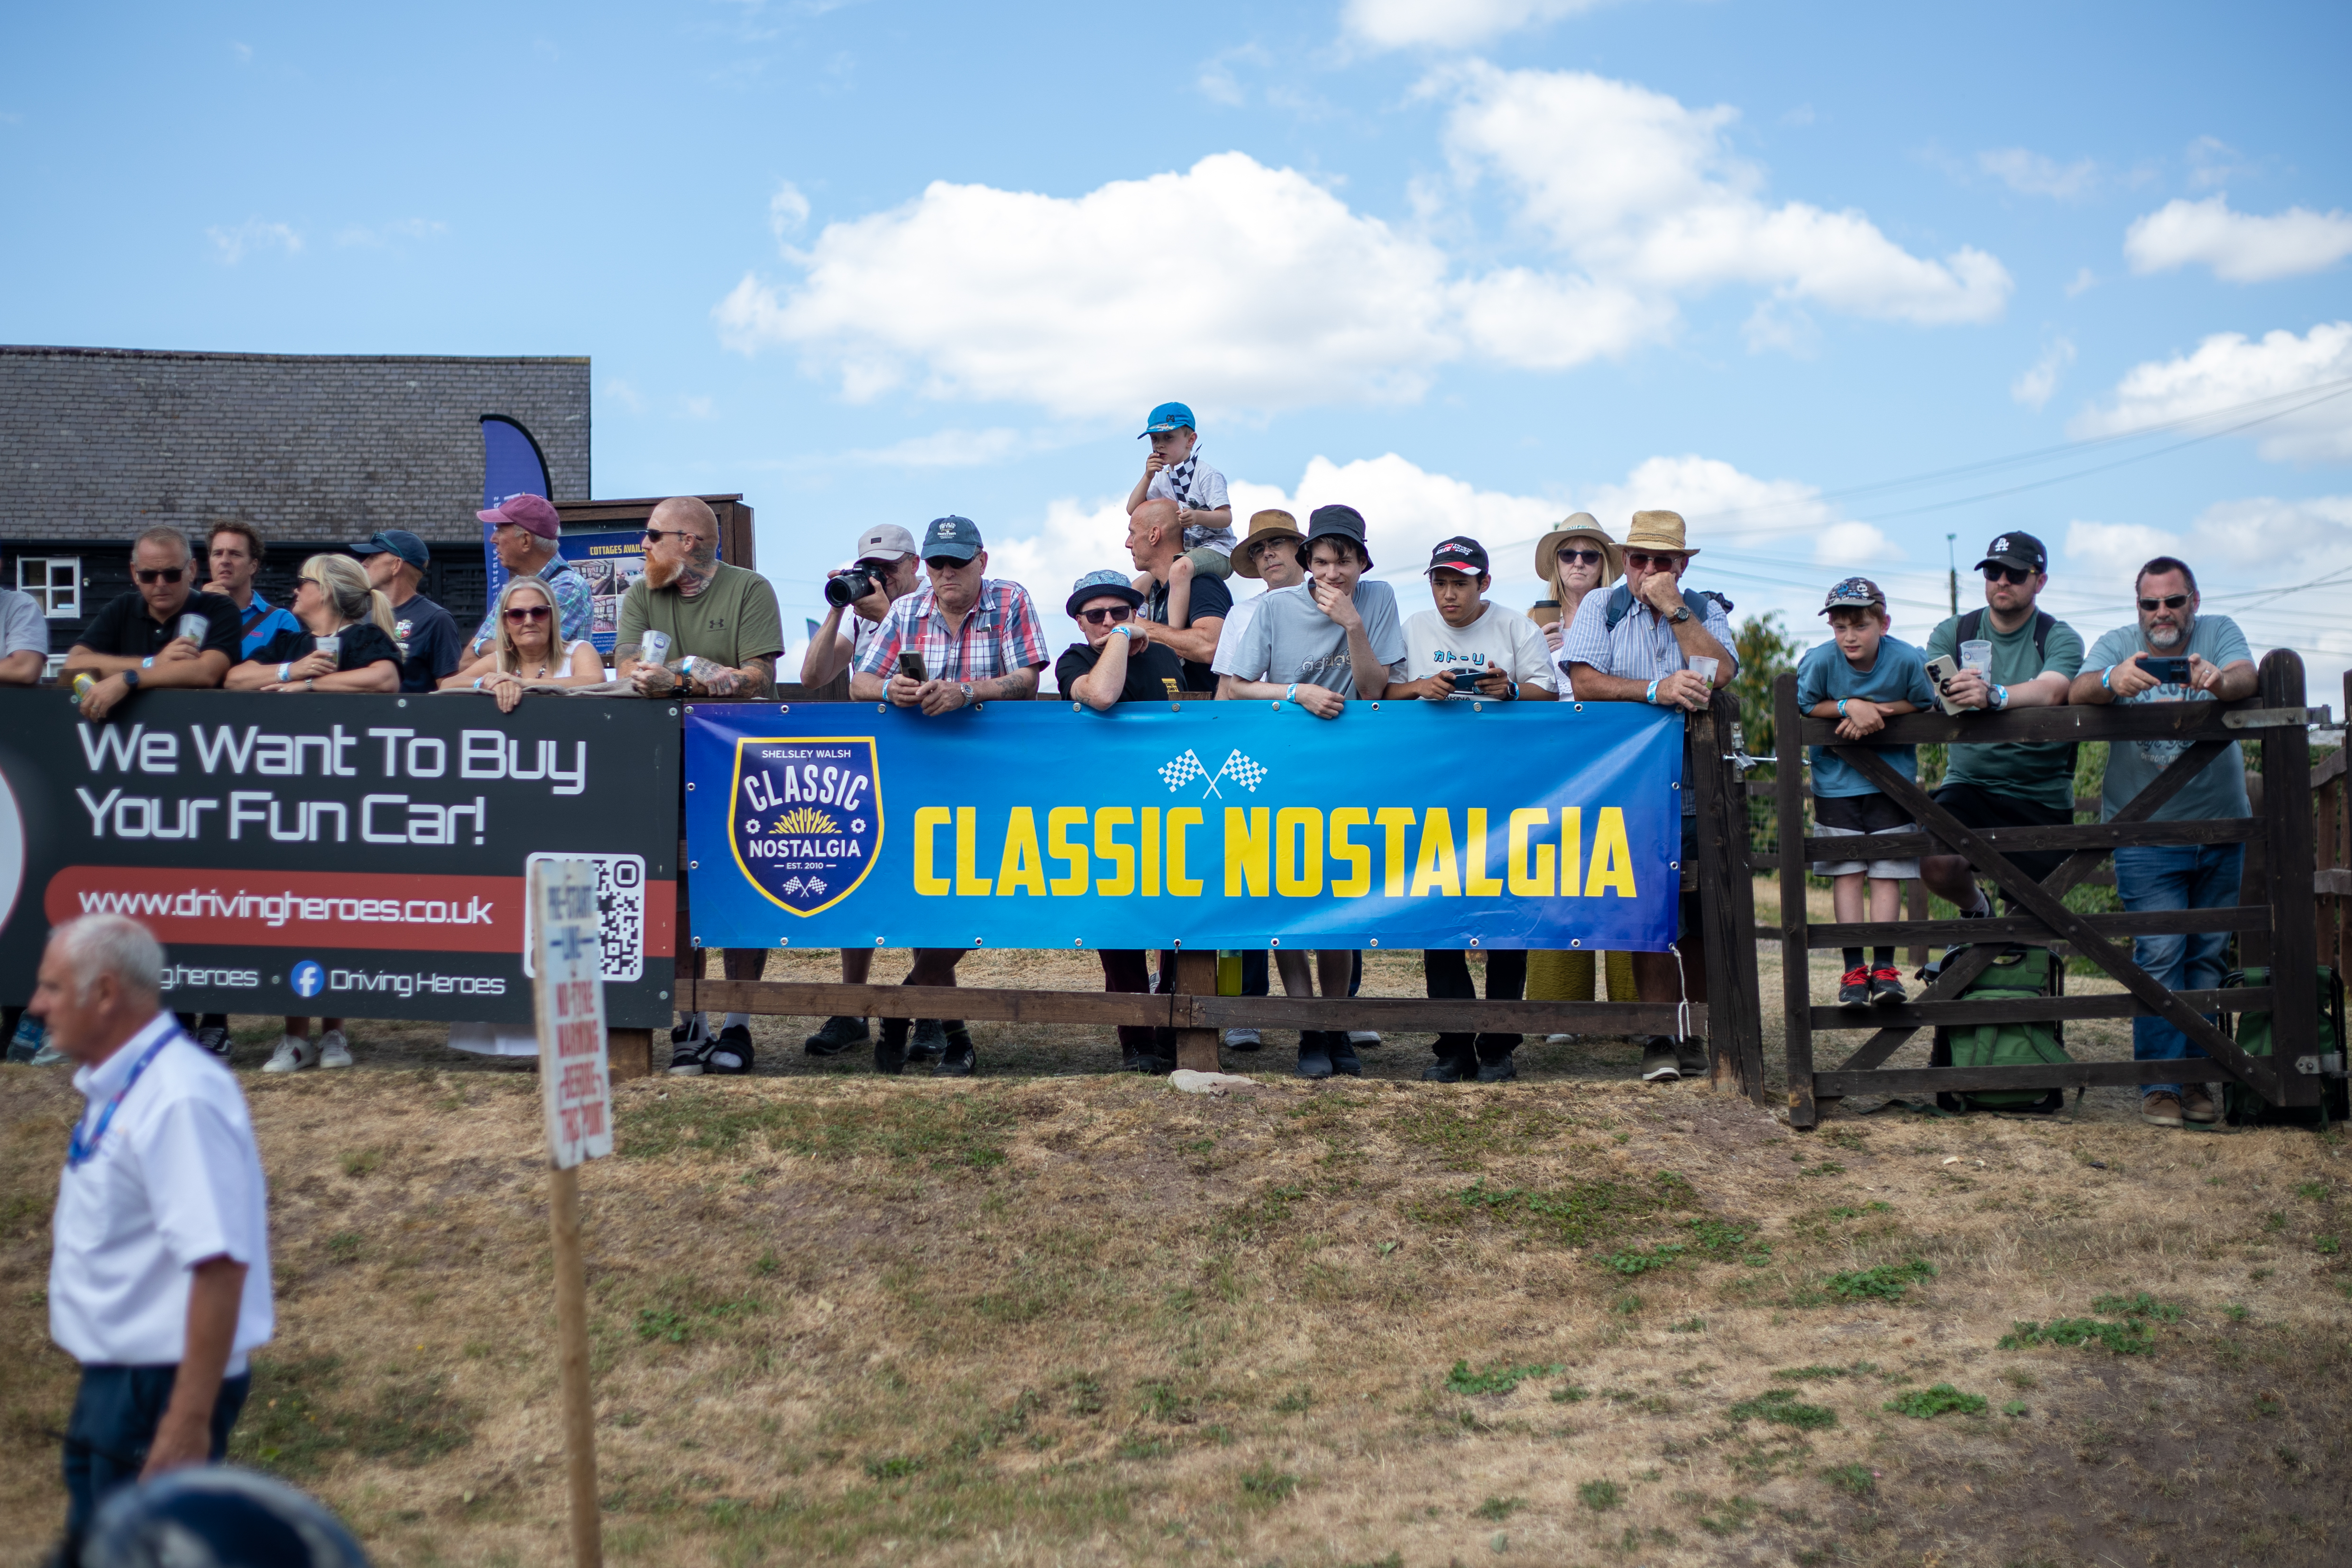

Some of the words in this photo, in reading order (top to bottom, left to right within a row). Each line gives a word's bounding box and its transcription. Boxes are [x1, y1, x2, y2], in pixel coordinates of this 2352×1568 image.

[589, 545, 622, 555] COTTAGES
[1454, 543, 1473, 552] TOYOTA
[77, 723, 177, 773] We
[192, 724, 357, 776] Want
[368, 728, 445, 778] To
[461, 730, 587, 795] Buy
[762, 750, 814, 759] SHELSLEY
[816, 750, 851, 758] WALSH
[744, 764, 868, 811] CLASSIC
[75, 788, 217, 839] Your
[230, 791, 346, 842] Fun
[362, 794, 484, 844] Car!
[750, 839, 862, 857] NOSTALGIA
[914, 806, 1204, 897] CLASSIC
[1224, 806, 1637, 898] NOSTALGIA
[78, 889, 494, 927] www.drivingheroes.co.uk
[160, 964, 258, 990] g.heroes
[330, 970, 413, 997] Driving
[417, 972, 506, 995] Heroes
